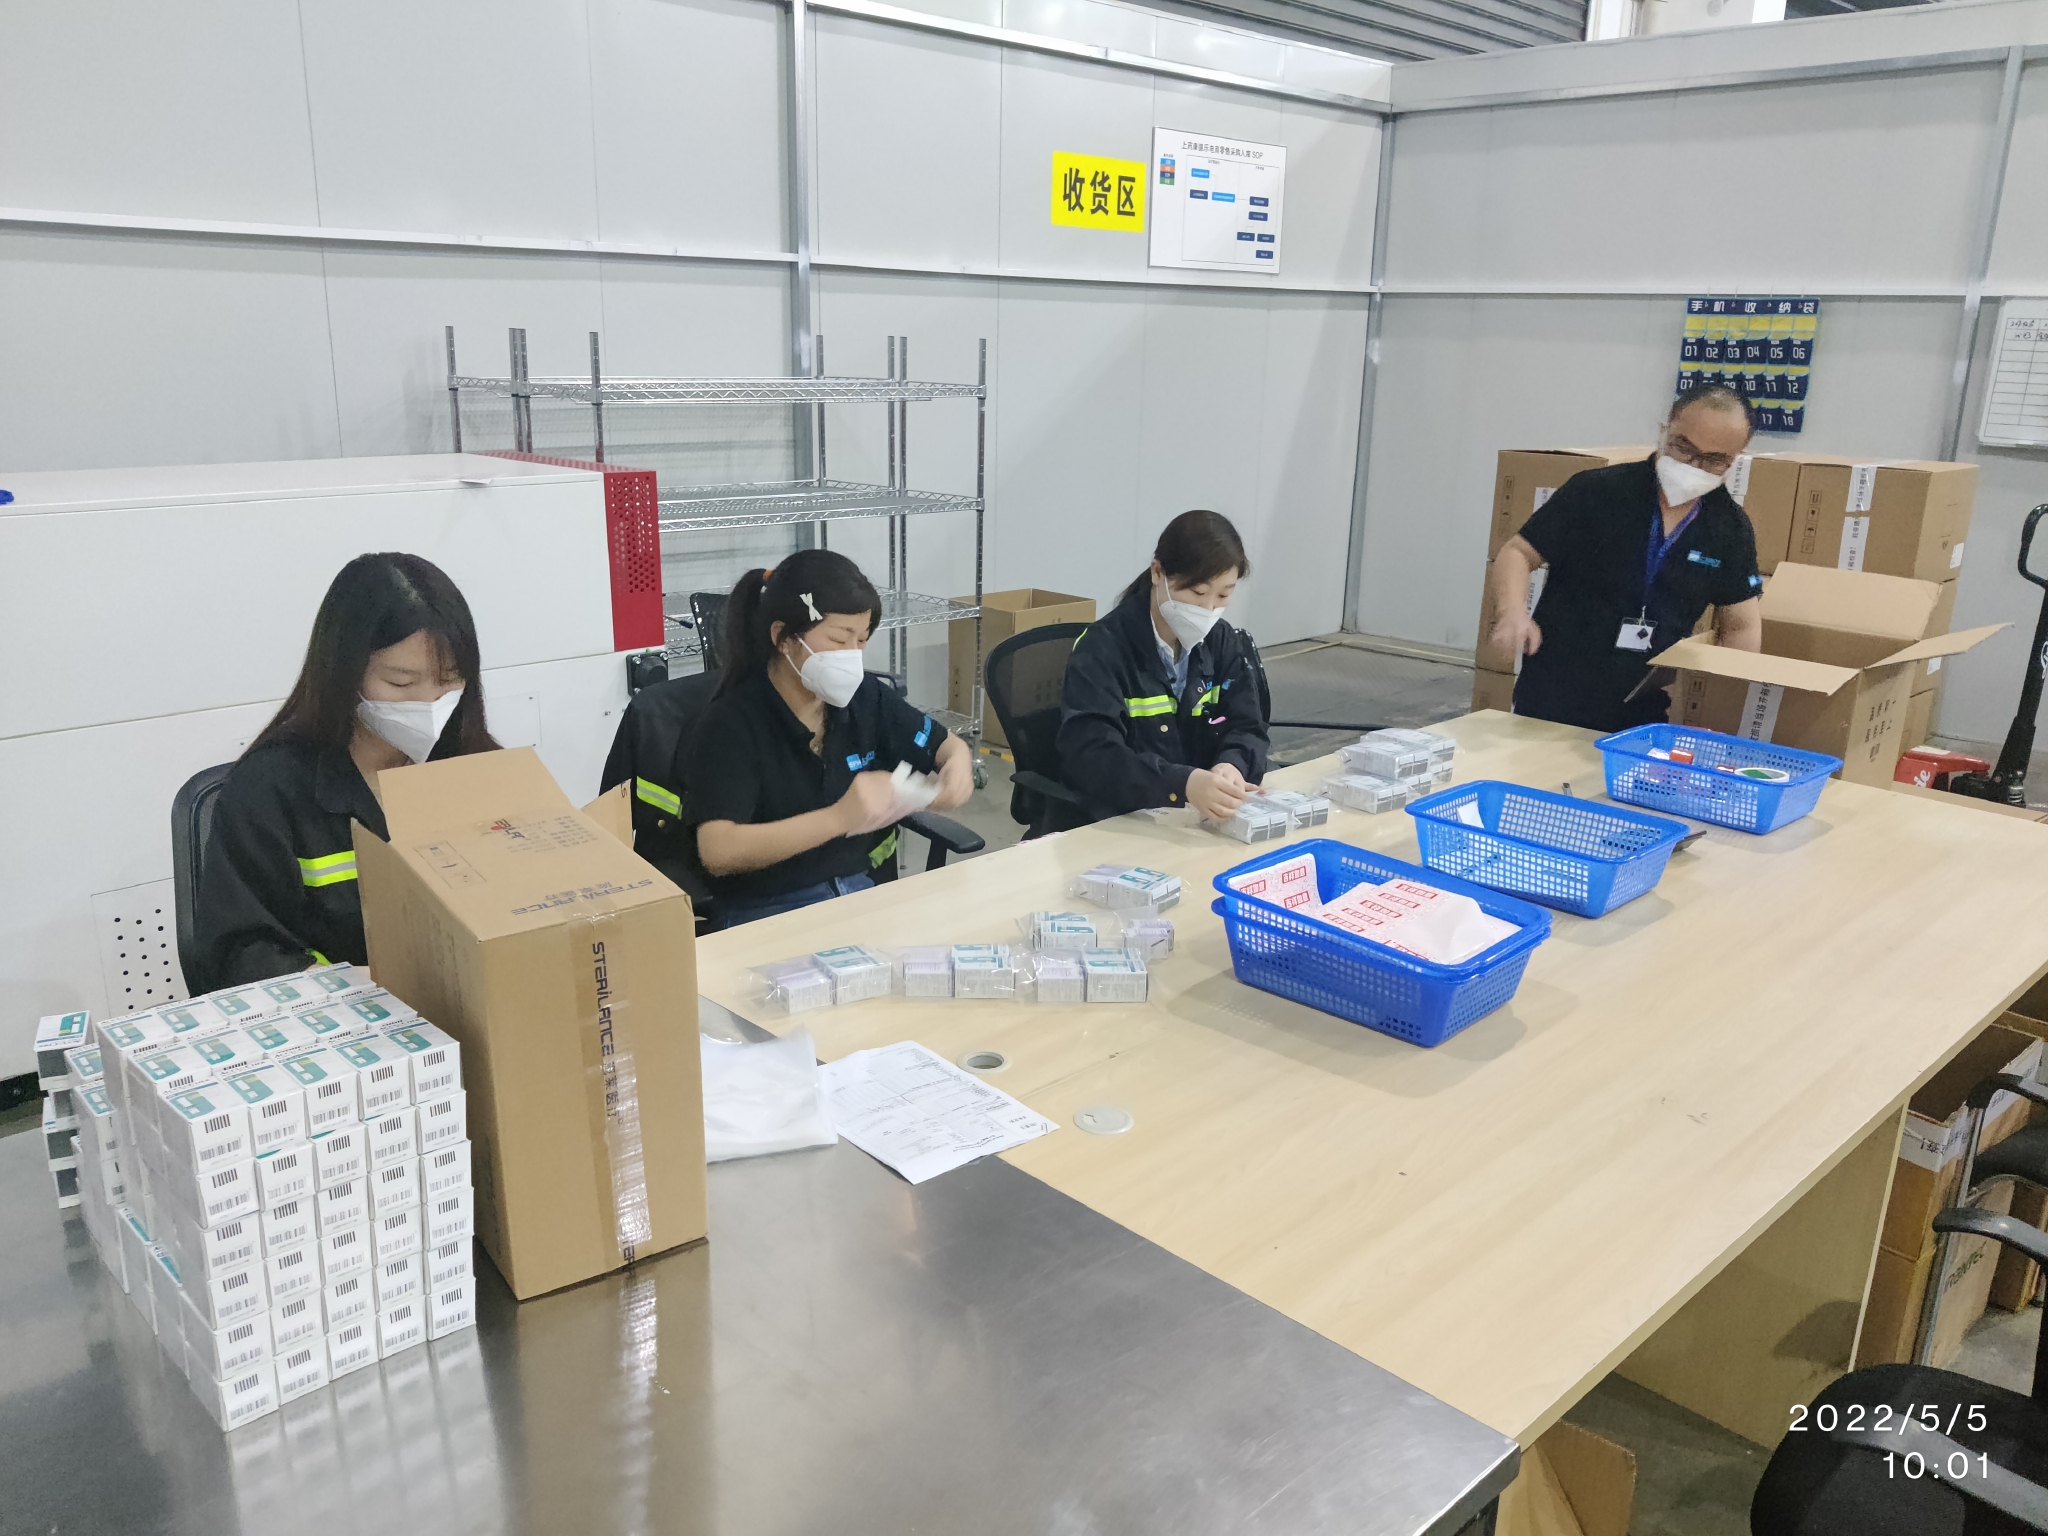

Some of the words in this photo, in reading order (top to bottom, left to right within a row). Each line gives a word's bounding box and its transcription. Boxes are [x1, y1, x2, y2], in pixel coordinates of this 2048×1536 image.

[1252, 151, 1264, 159] SOP
[1063, 167, 1136, 217] 收货区
[1685, 346, 1698, 357] 01
[1706, 347, 1718, 358] 02
[1727, 347, 1740, 358] 03
[1747, 346, 1760, 357] 04
[1770, 347, 1783, 359] 05
[1793, 347, 1805, 359] 06
[1680, 379, 1693, 390] 07
[1744, 380, 1756, 391] 10
[1765, 382, 1777, 392] 11
[1788, 382, 1799, 394] 12
[1762, 413, 1772, 425] 17
[1783, 415, 1794, 426] 18
